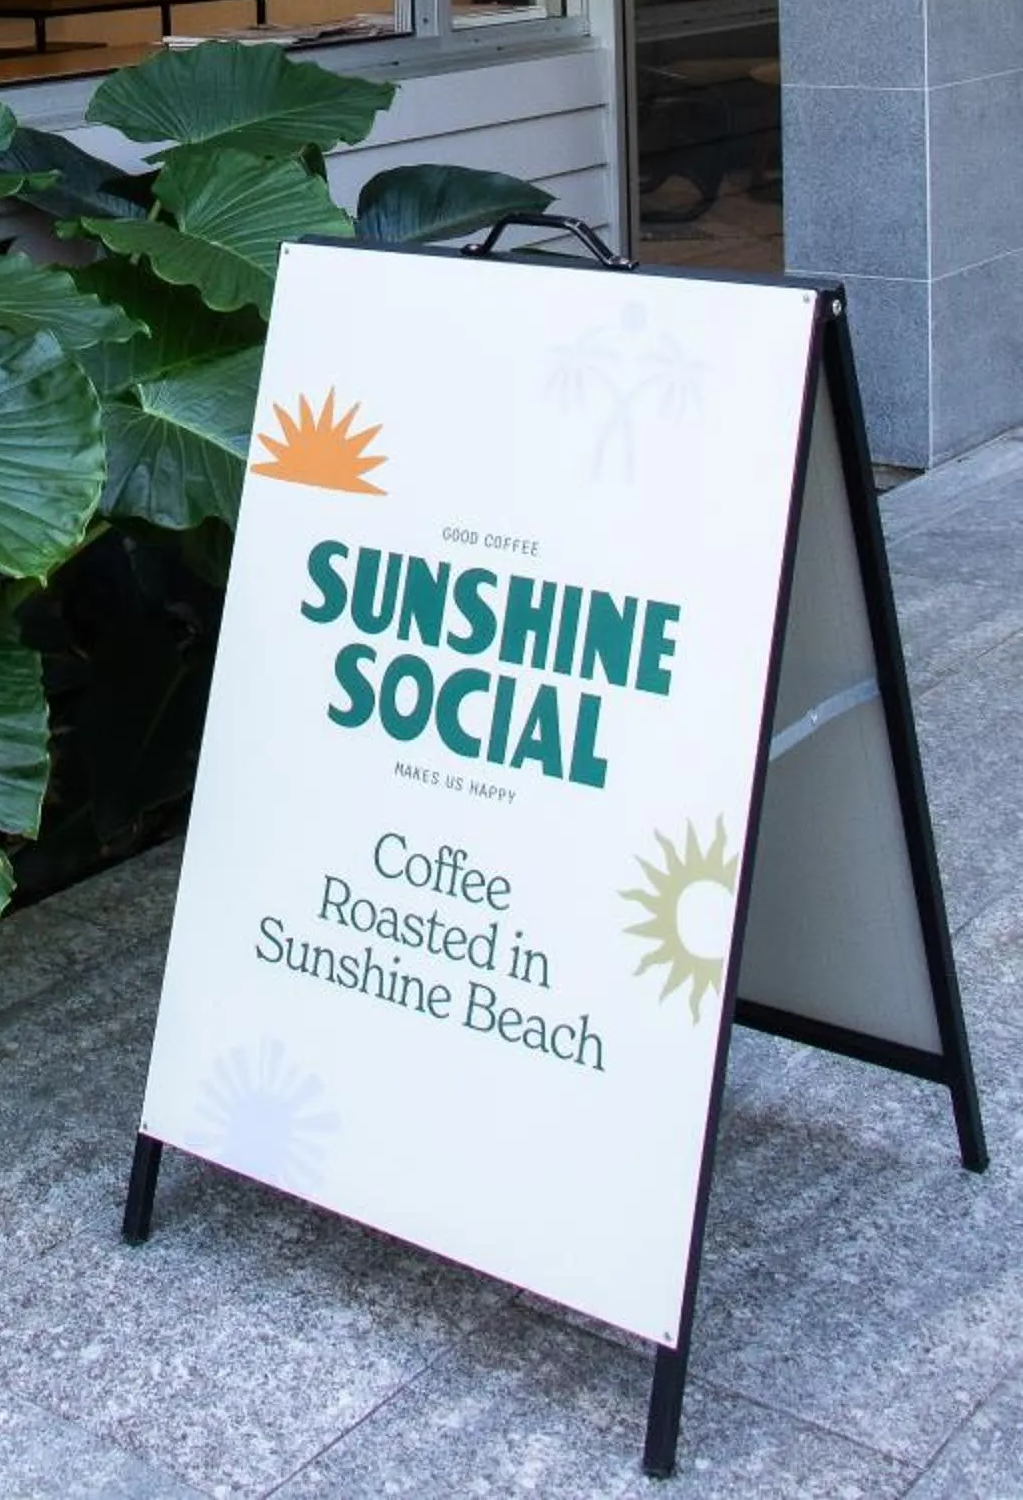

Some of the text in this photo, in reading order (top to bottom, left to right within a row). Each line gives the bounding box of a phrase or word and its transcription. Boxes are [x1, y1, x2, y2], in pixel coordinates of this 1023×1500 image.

[442, 526, 539, 557] GOOD COFFEE
[300, 539, 681, 696] SUNSHINE
[327, 642, 608, 789] SOCIAL
[394, 761, 516, 804] MAKES US HAPPY
[374, 833, 512, 911] Coffee
[317, 875, 551, 989] Roasted in
[254, 916, 605, 1072] Sunshine Beach
